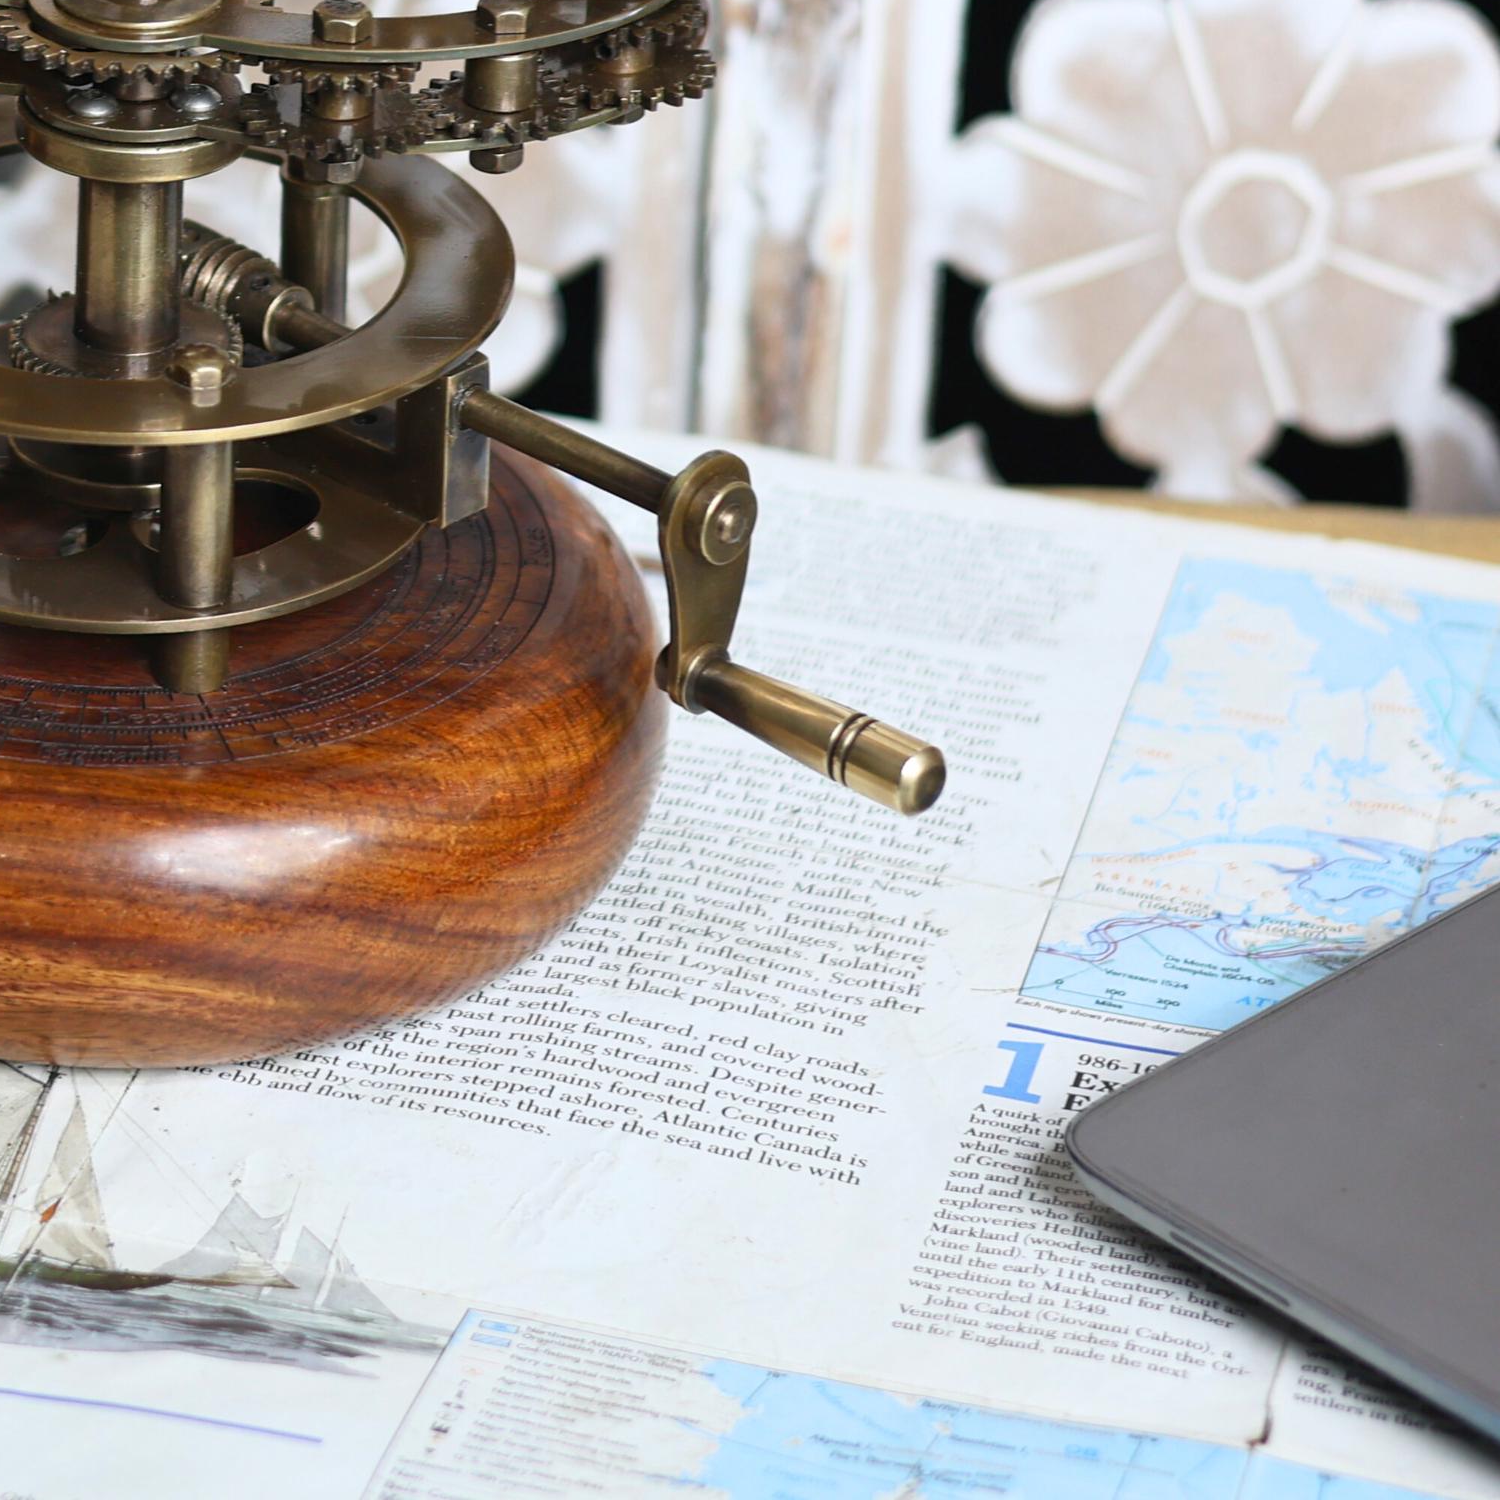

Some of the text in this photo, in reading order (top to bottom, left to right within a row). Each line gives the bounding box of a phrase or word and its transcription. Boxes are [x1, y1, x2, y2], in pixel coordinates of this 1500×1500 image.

[559, 937, 923, 1014] with their Loyalist masters after
[516, 998, 600, 1018] settlers
[606, 1011, 692, 1039] cleared,
[708, 1033, 747, 1048] red
[753, 1042, 798, 1064] clay
[806, 1056, 868, 1076] roads
[1014, 997, 1043, 1010] Each
[1044, 1005, 1068, 1017] map
[1069, 1008, 1102, 1021] shows
[447, 1008, 882, 1097] past rolling farms, and covered wood-
[982, 1040, 1045, 1104] 1
[217, 1069, 549, 1134] ebb and flow of its resources.
[342, 1039, 837, 1142] of the interior remains forested. Centuries
[346, 1060, 453, 1081] explorers
[460, 1072, 553, 1098] stepped
[559, 1093, 644, 1119] ashore,
[653, 1109, 746, 1140] Atlantic
[752, 1131, 842, 1162] Canada
[850, 1153, 866, 1168] is
[974, 1101, 1062, 1126] A quirk of
[953, 1153, 1082, 1186] of Greenland,
[918, 1251, 964, 1265] until
[967, 1256, 989, 1269] the
[1002, 1264, 1045, 1279] early
[1055, 1268, 1096, 1284] 11th
[1101, 1279, 1176, 1301] century,
[922, 1235, 969, 1251] (vine
[975, 1243, 1022, 1261] land).
[1036, 1250, 1083, 1267] Their
[930, 1221, 1163, 1269] Markland (wooded land),
[907, 1279, 941, 1291] was
[947, 1286, 1032, 1304] recorded
[1037, 1295, 1055, 1307] in
[912, 1265, 1239, 1329] expedition to Markland for timber
[925, 1293, 968, 1310] John
[973, 1302, 1031, 1318] Cabot
[1034, 1310, 1129, 1335] (Giovanni
[1134, 1327, 1216, 1357] Caboto),
